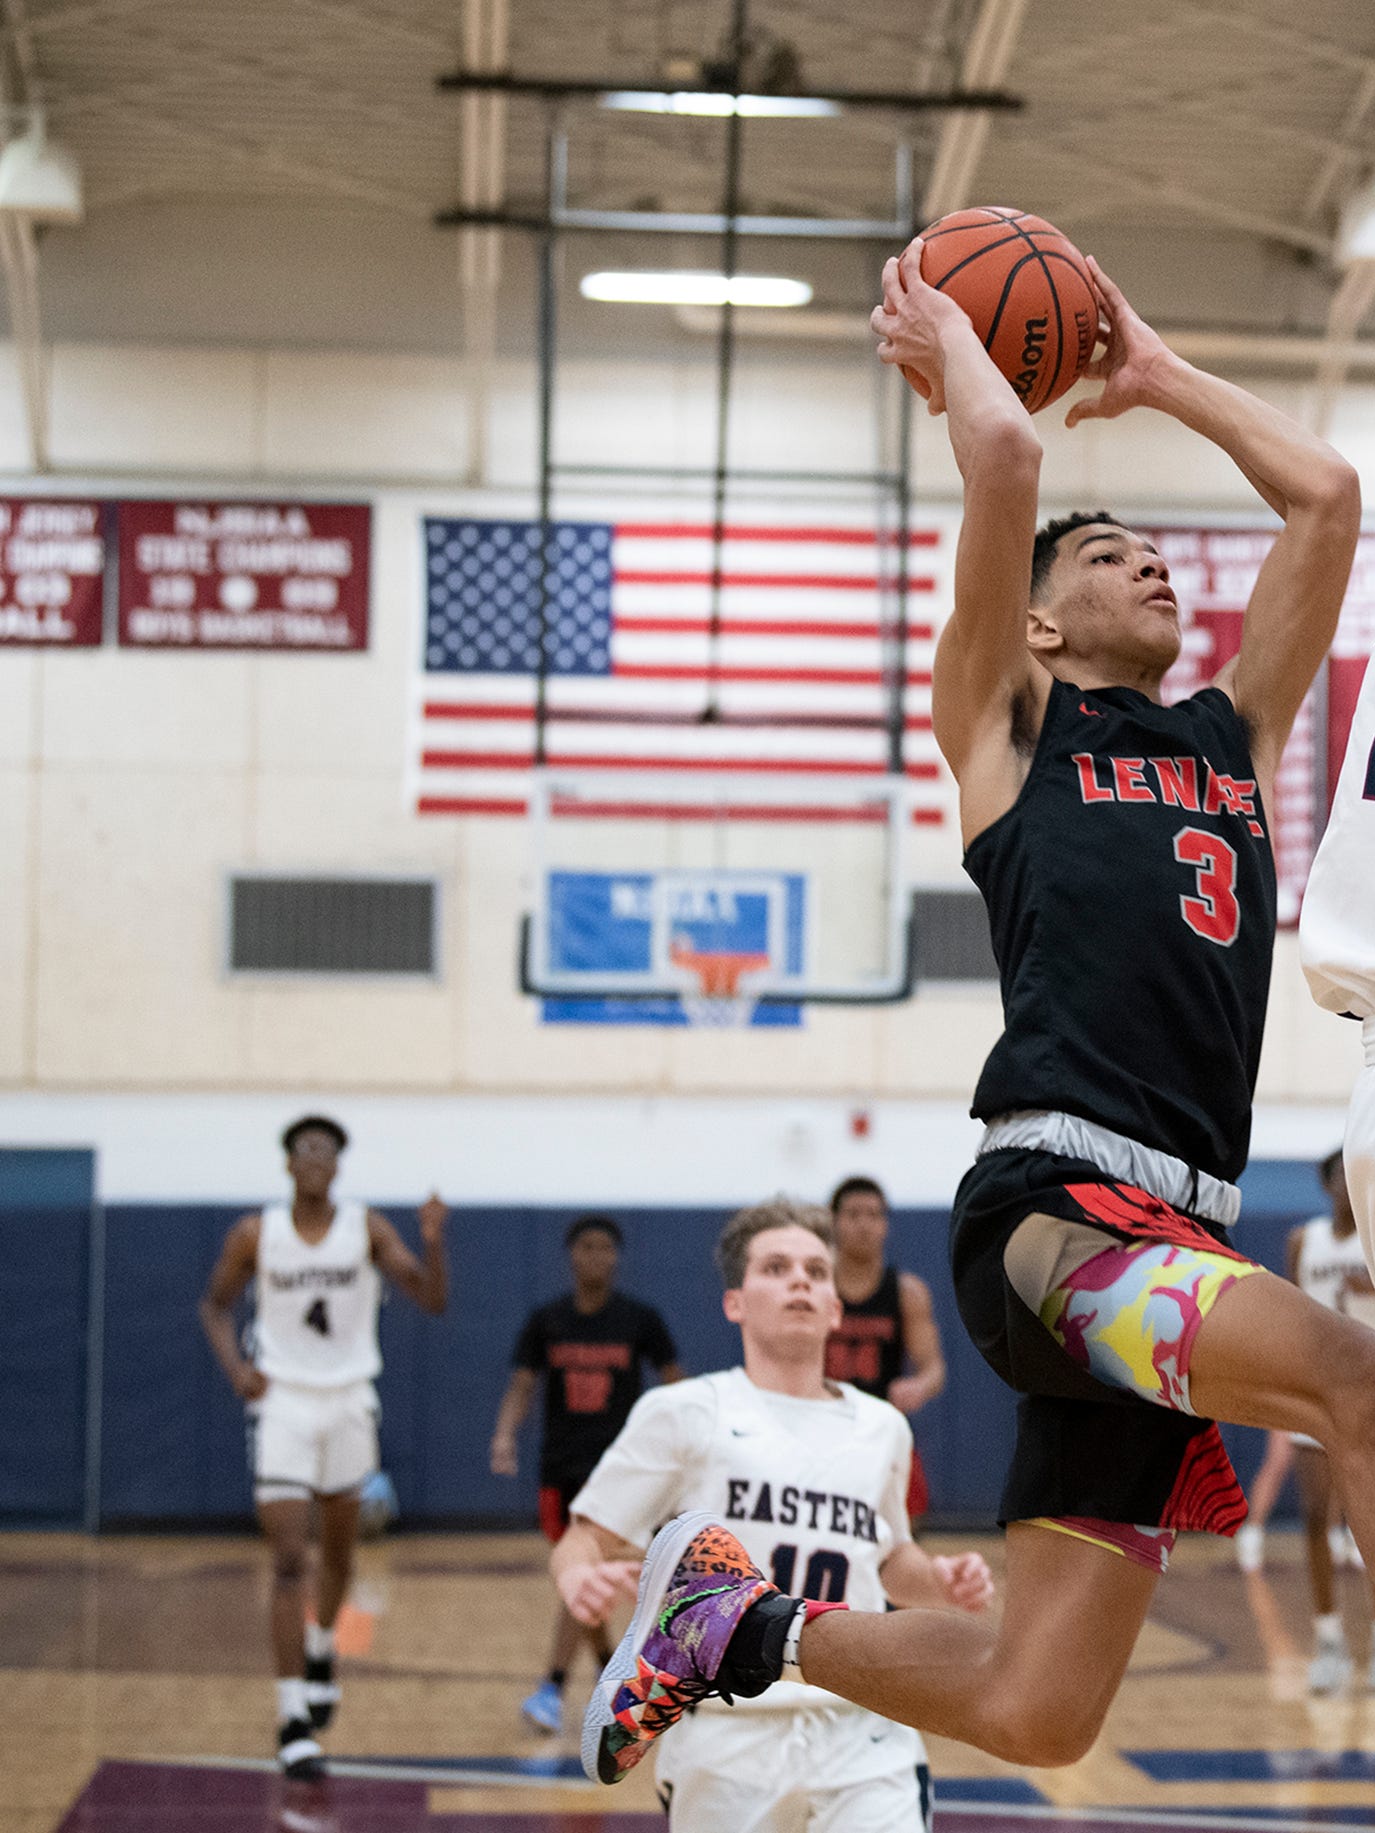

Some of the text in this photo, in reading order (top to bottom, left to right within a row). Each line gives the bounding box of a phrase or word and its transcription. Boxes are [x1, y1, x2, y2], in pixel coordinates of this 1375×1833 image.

[1172, 826, 1240, 948] 3
[304, 1298, 330, 1338] 4
[770, 1543, 850, 1601] 10
